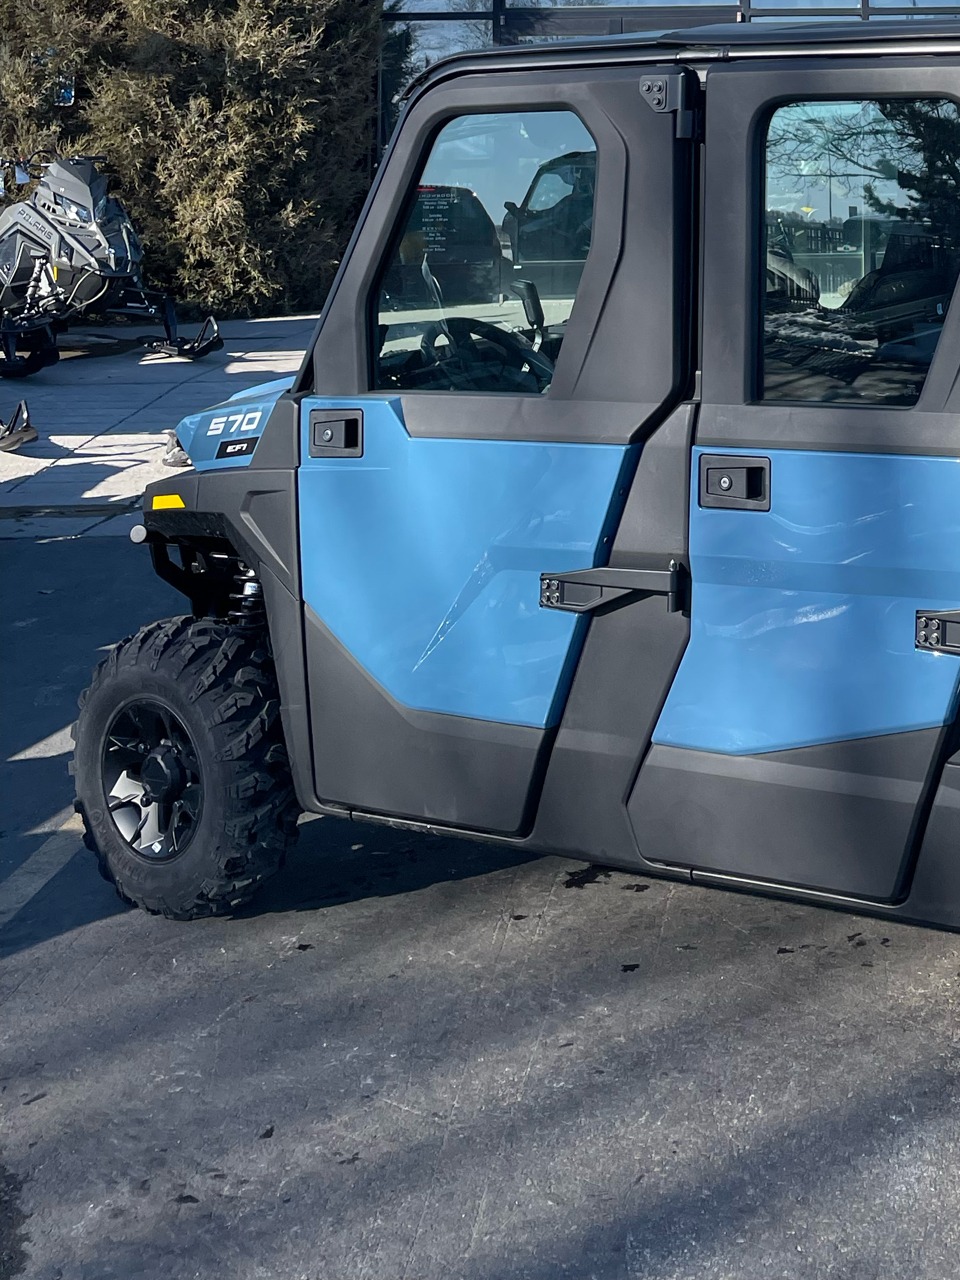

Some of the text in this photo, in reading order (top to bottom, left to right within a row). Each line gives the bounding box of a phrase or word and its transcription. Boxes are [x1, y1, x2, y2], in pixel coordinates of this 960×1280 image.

[17, 208, 54, 240] POLARIS
[206, 411, 263, 437] 570
[226, 443, 248, 453] EFI
